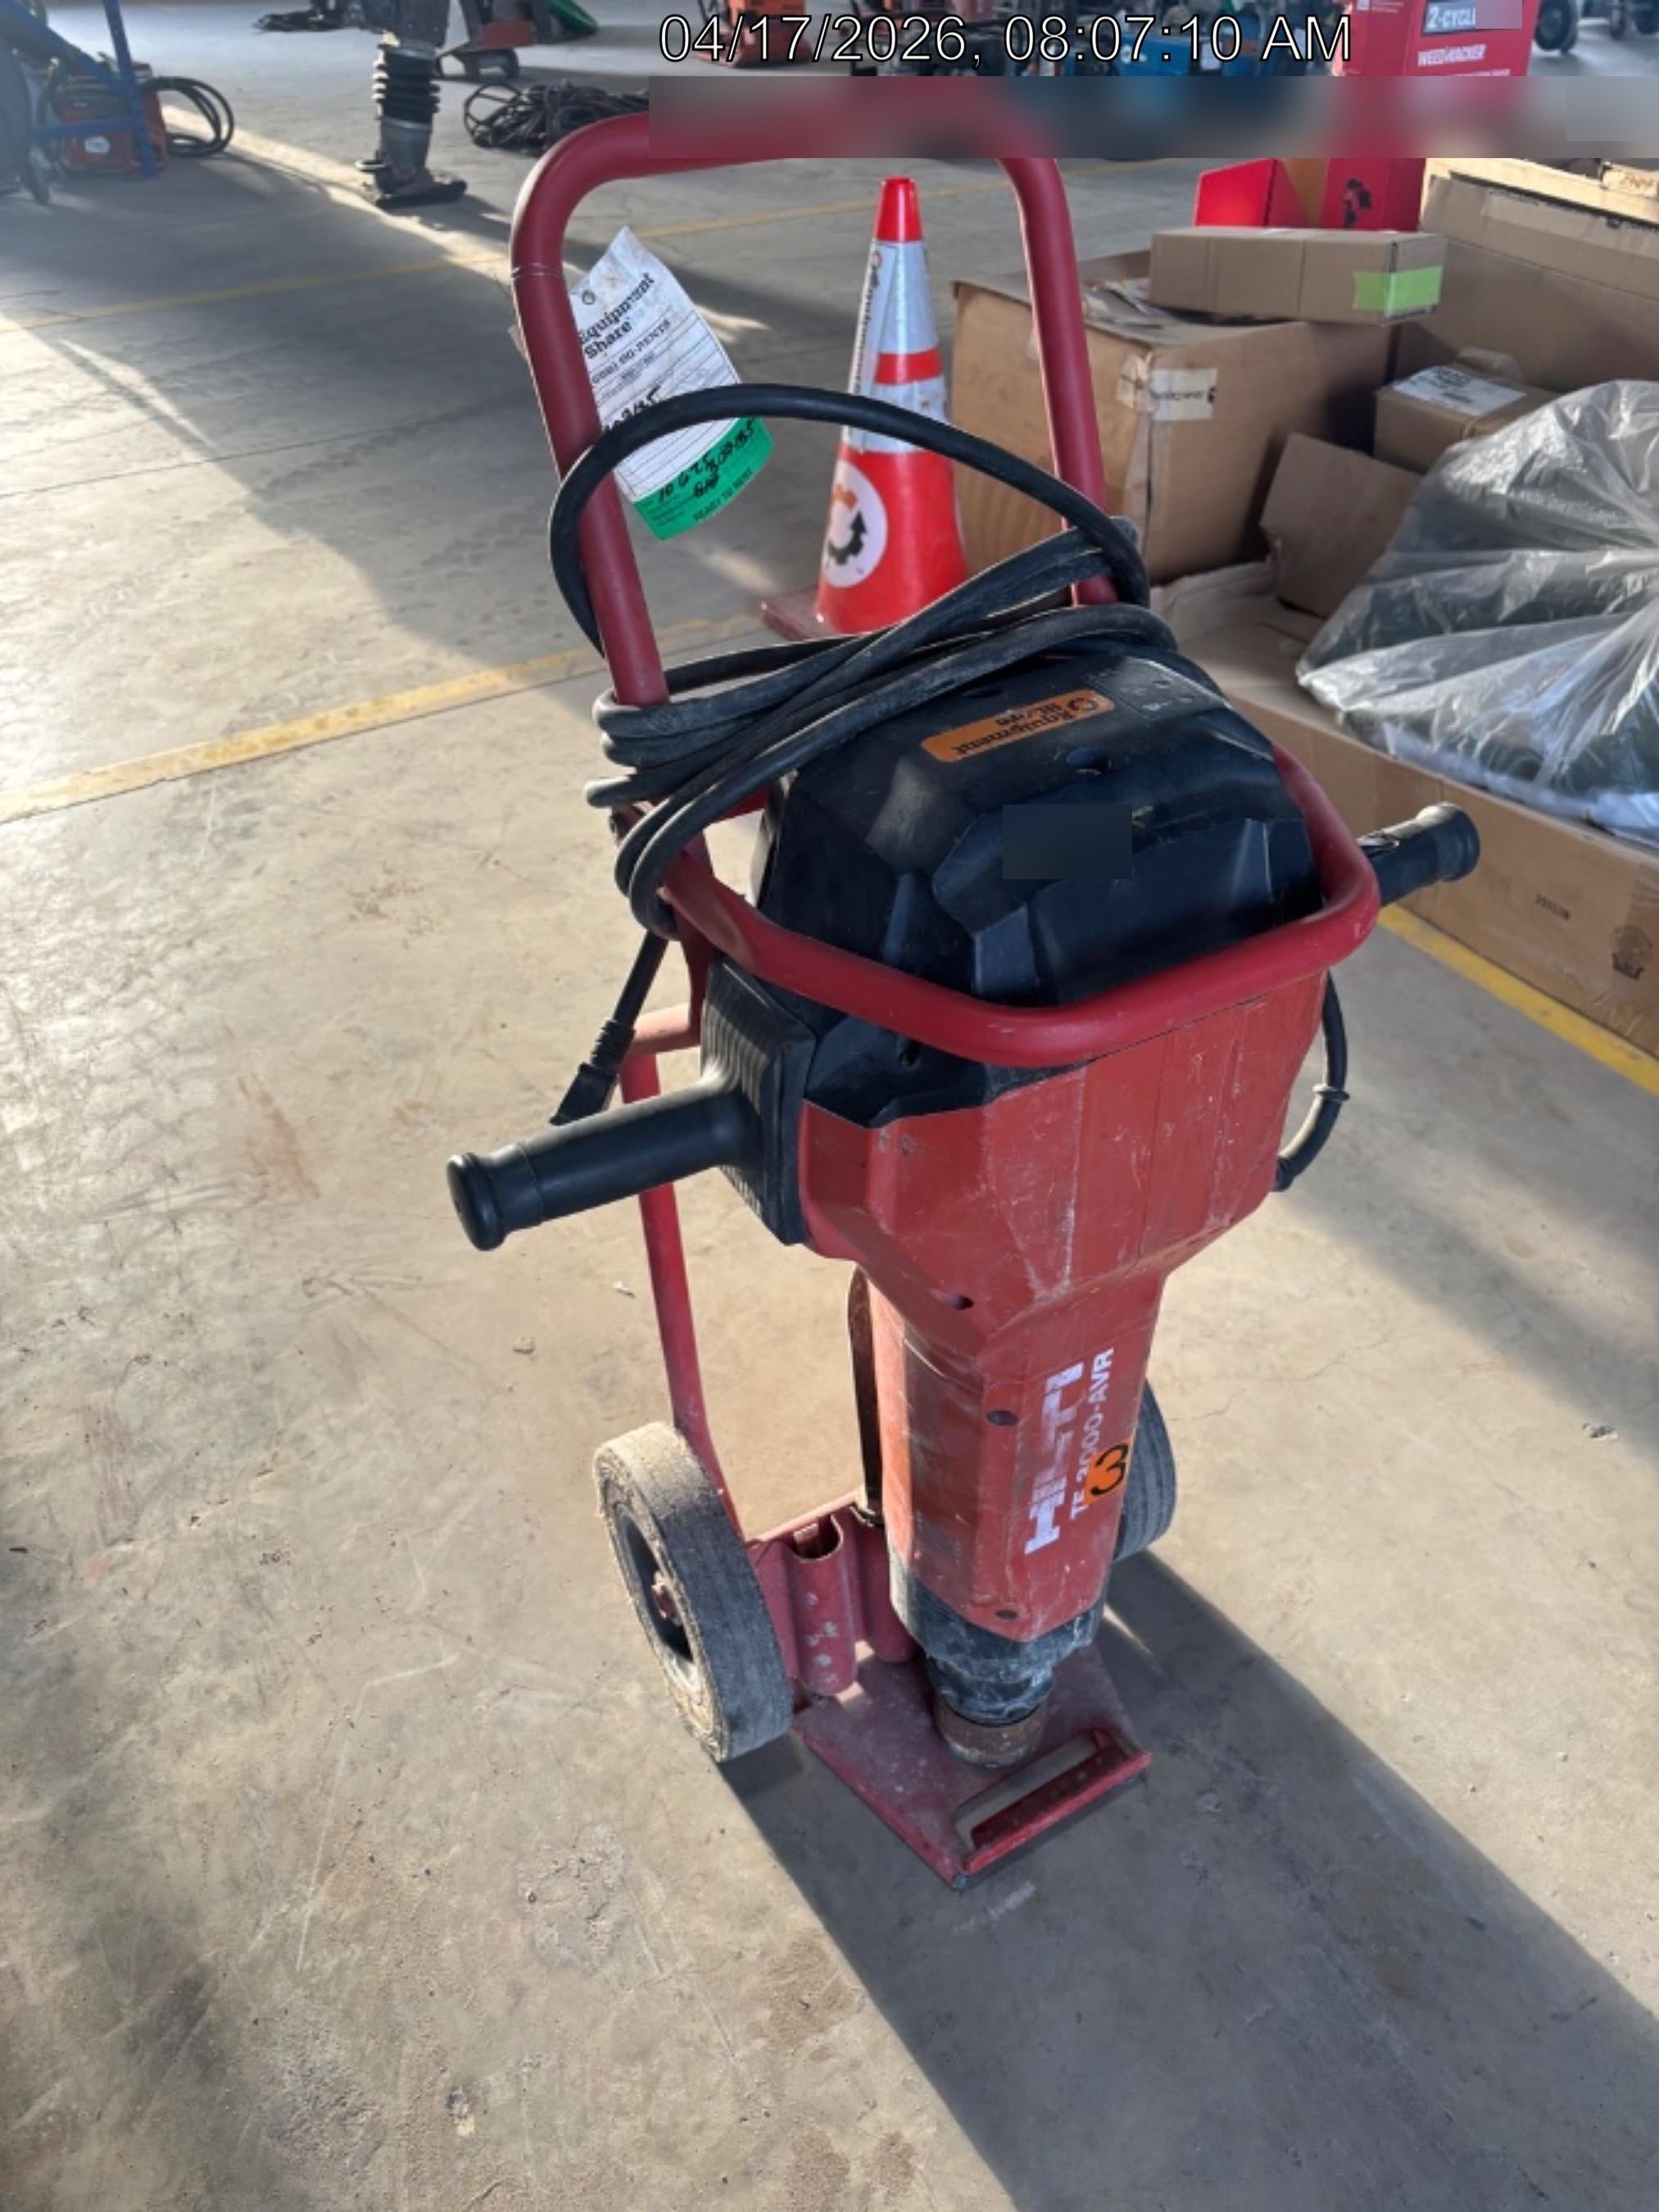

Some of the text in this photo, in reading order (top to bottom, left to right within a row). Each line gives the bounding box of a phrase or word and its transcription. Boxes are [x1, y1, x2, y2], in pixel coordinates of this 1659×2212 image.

[584, 320, 632, 359] Share
[1024, 1362, 1085, 1556] HILTI
[1090, 1443, 1129, 1496] 3
